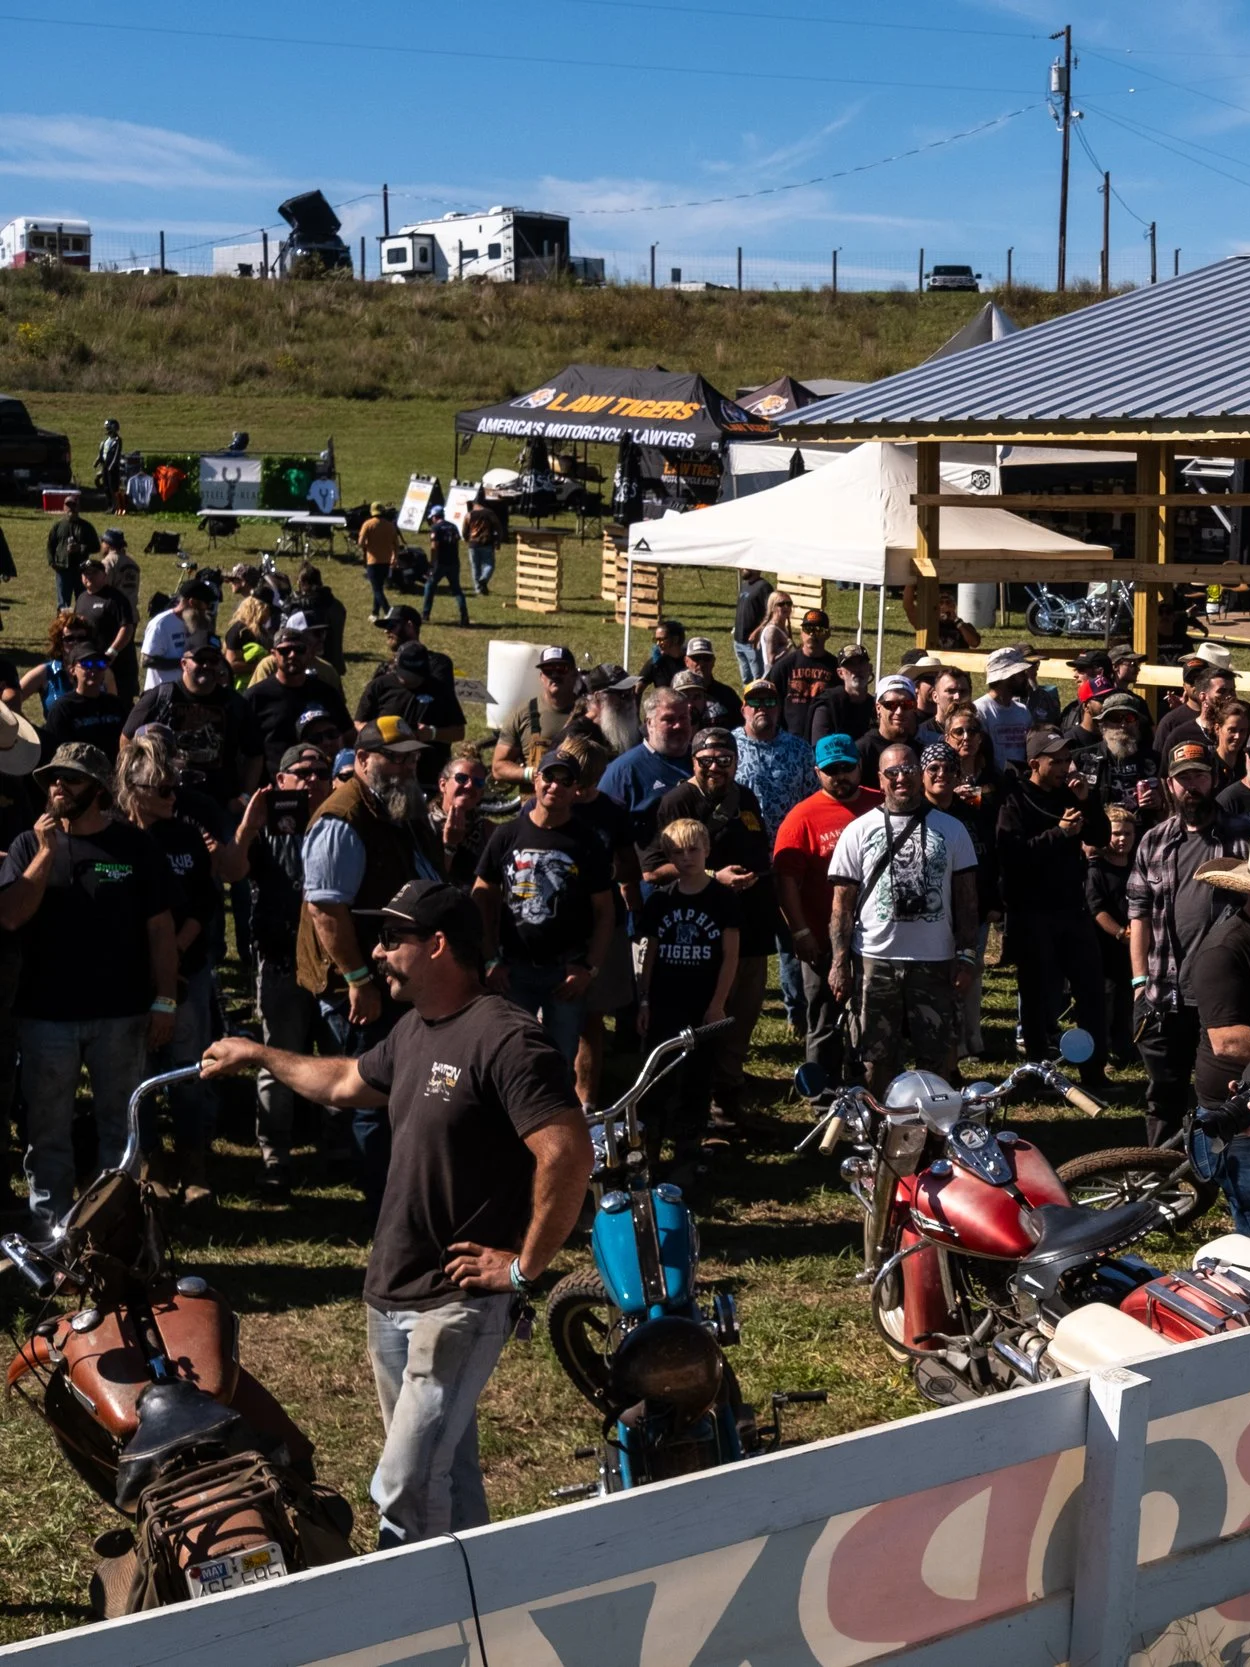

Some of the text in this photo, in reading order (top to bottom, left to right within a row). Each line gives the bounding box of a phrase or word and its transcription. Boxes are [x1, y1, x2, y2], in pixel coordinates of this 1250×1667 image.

[546, 392, 700, 421] LAW TIGERS
[477, 417, 696, 448] AMERICA'S MOTORCYCL LAWYERS
[792, 667, 832, 680] LUCKY'S
[658, 908, 720, 939] MEMPHIS
[659, 944, 712, 960] TIGERS
[202, 1564, 224, 1579] MAY
